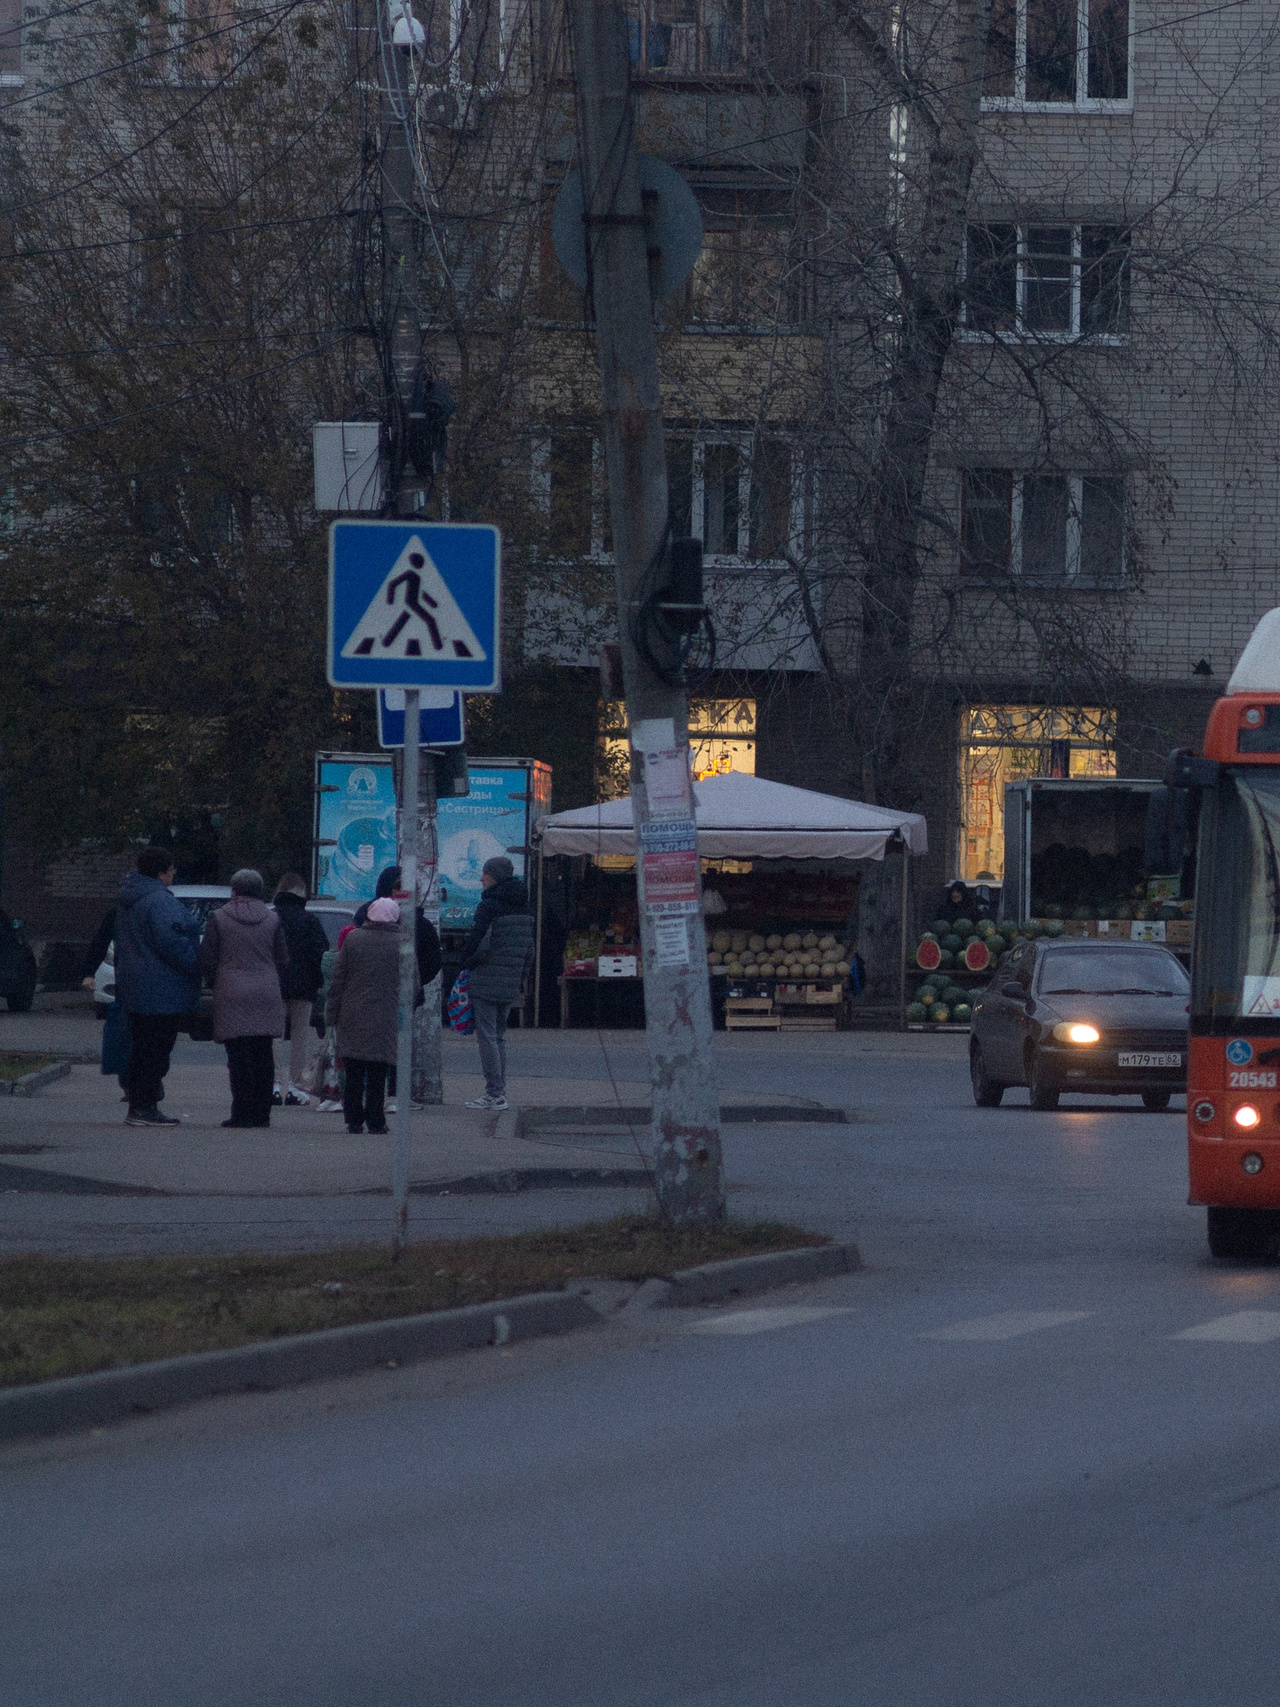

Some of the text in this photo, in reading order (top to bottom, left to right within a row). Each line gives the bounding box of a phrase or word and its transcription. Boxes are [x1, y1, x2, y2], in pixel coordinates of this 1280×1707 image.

[469, 776, 503, 785] тавка
[467, 791, 492, 800] оды
[642, 823, 694, 833] ПОМОЩЬ
[1230, 1071, 1277, 1087] 20543
